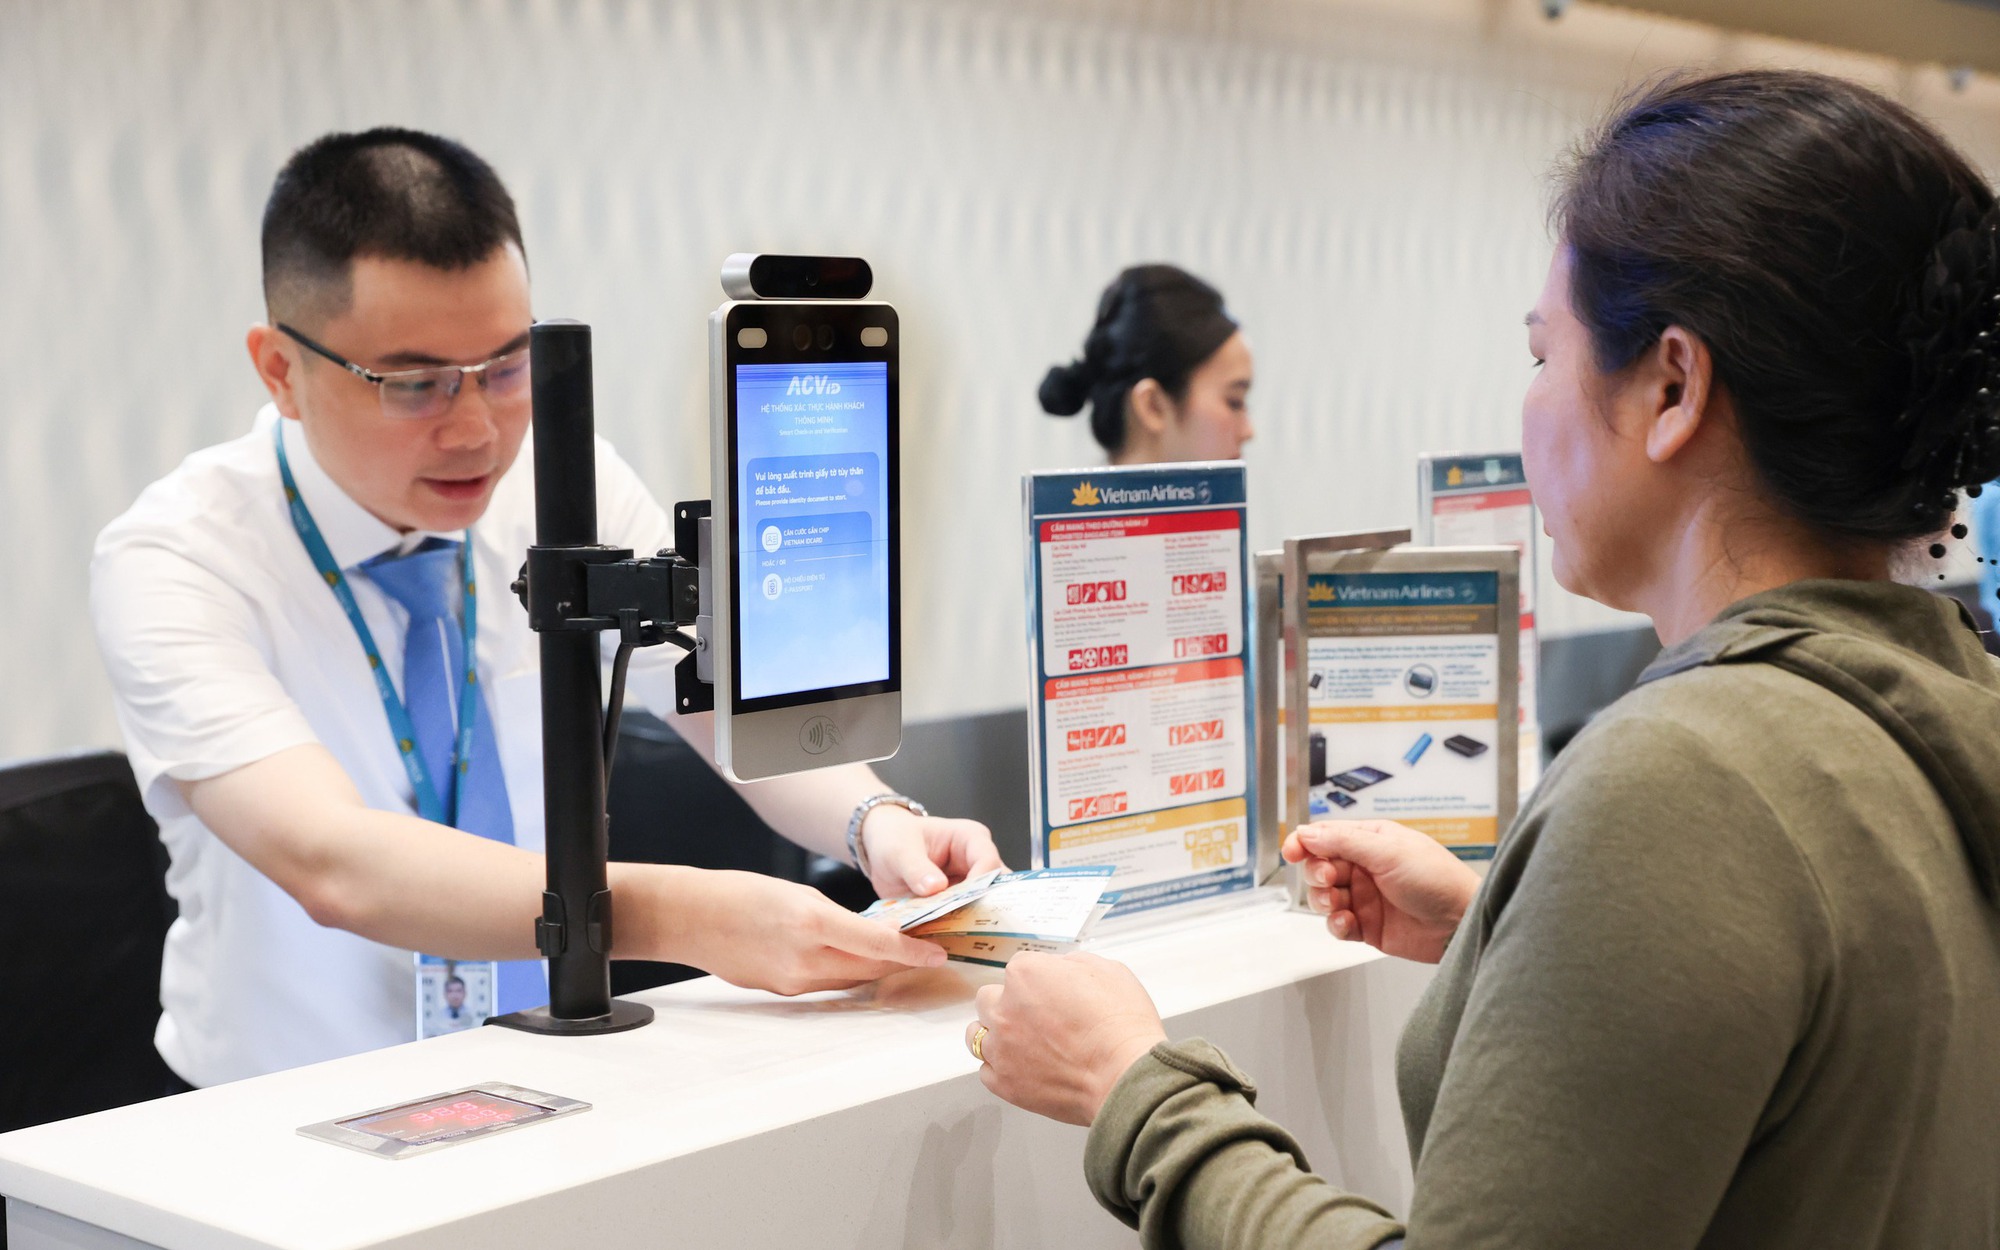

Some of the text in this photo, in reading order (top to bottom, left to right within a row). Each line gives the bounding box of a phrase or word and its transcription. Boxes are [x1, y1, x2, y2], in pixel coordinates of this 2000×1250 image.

[760, 403, 770, 414] HỆ
[771, 402, 793, 413] THỐNG
[794, 402, 807, 412] XÁC
[825, 401, 843, 411] HÀNH
[843, 401, 865, 411] KHÁCH
[794, 415, 833, 425] THÔNG MINH
[755, 472, 766, 481] Vui
[767, 471, 782, 482] lòng
[783, 469, 798, 480] xuất
[799, 469, 815, 479] trình
[815, 467, 829, 479] giấy
[830, 468, 837, 477] tờ
[849, 466, 864, 476] thân
[755, 484, 792, 495] để bắt đầu.
[771, 498, 789, 506] provide
[783, 538, 805, 546] VIETNAM
